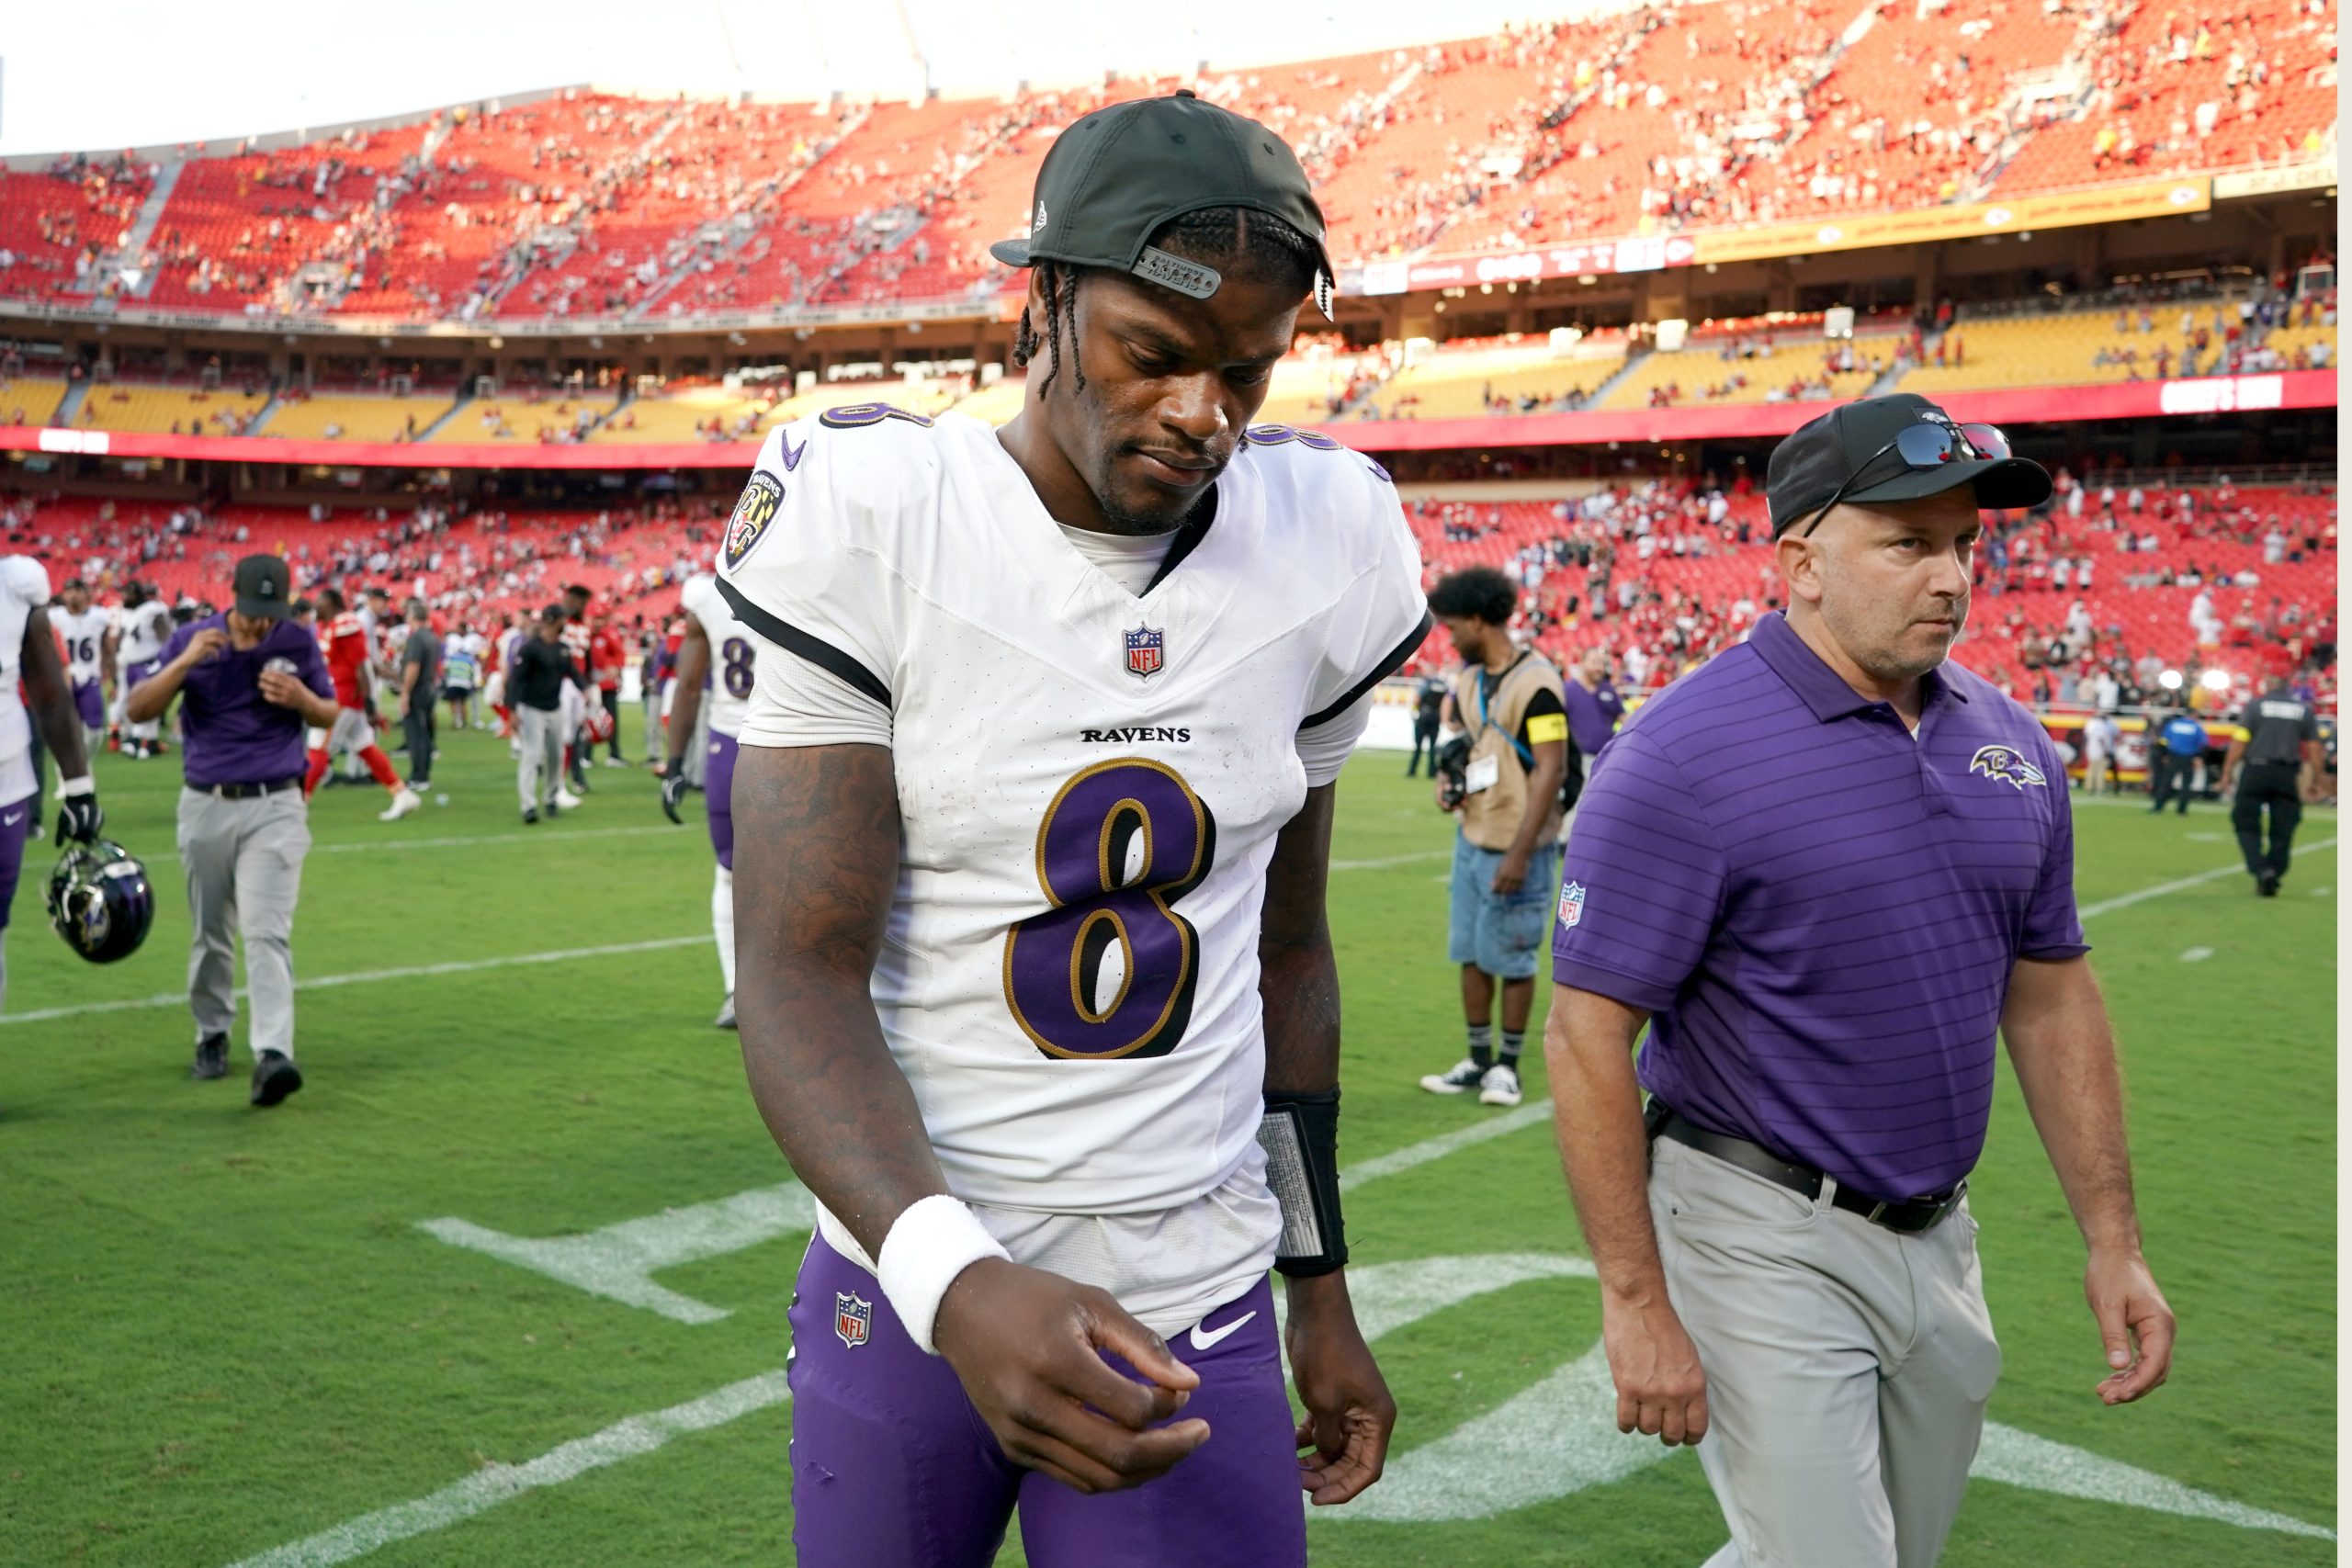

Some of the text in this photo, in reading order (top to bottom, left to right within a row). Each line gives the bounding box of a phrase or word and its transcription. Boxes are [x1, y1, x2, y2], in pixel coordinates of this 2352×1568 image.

[1131, 649, 1160, 672] NFL
[1080, 727, 1191, 743] RAVENS
[1002, 757, 1216, 1060] 8
[1560, 900, 1578, 921] NFL
[840, 1314, 864, 1338] NFL
